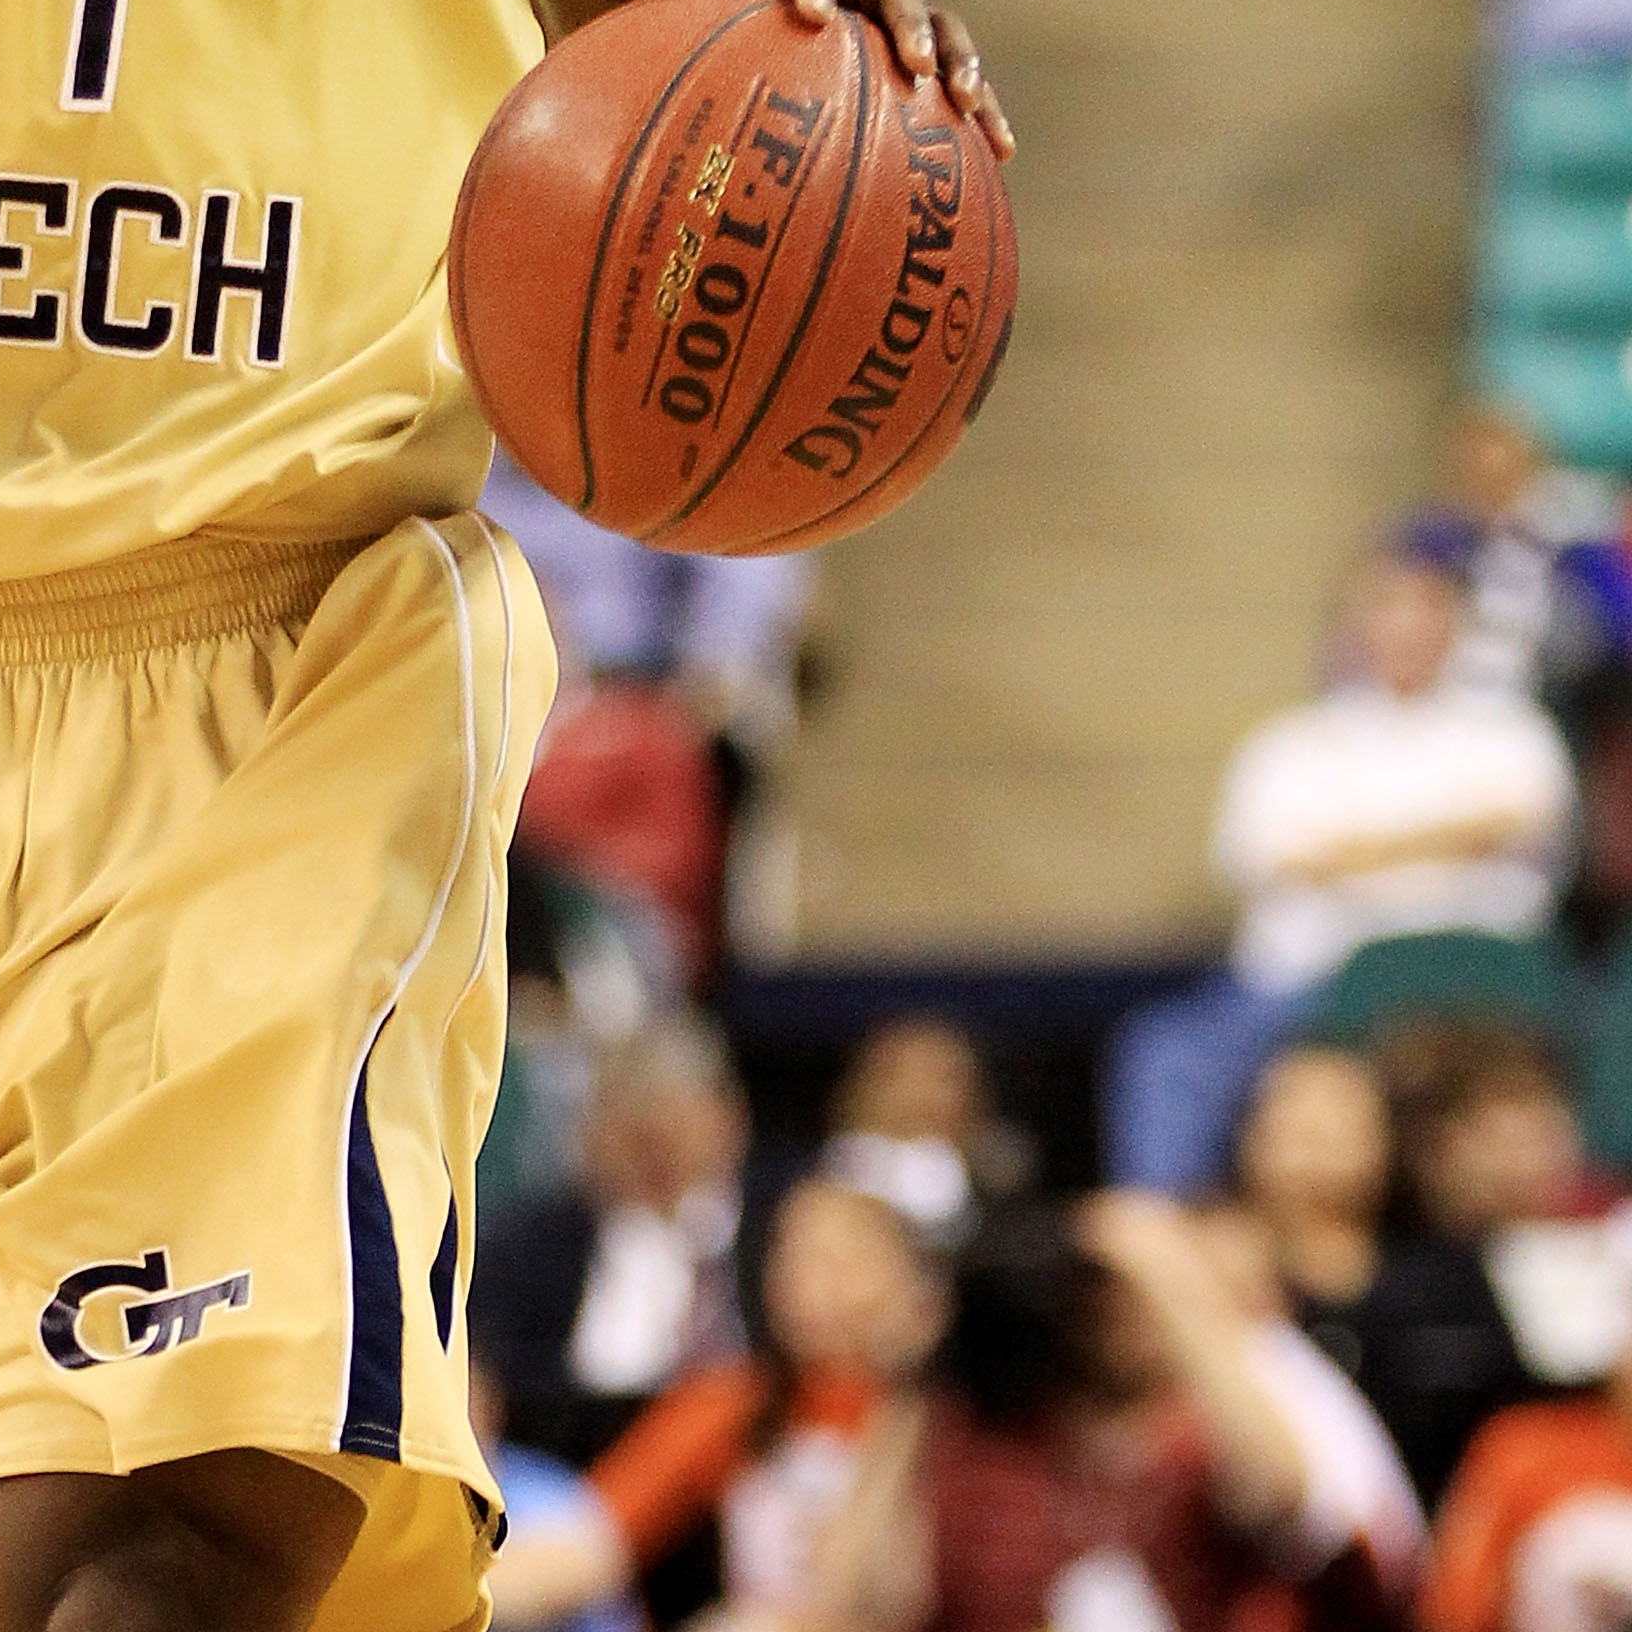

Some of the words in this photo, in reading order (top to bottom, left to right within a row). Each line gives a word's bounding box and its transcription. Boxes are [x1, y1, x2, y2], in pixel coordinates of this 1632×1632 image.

[654, 221, 706, 325] PRO
[782, 104, 960, 479] SPALDING
[37, 1245, 252, 1372] GT
